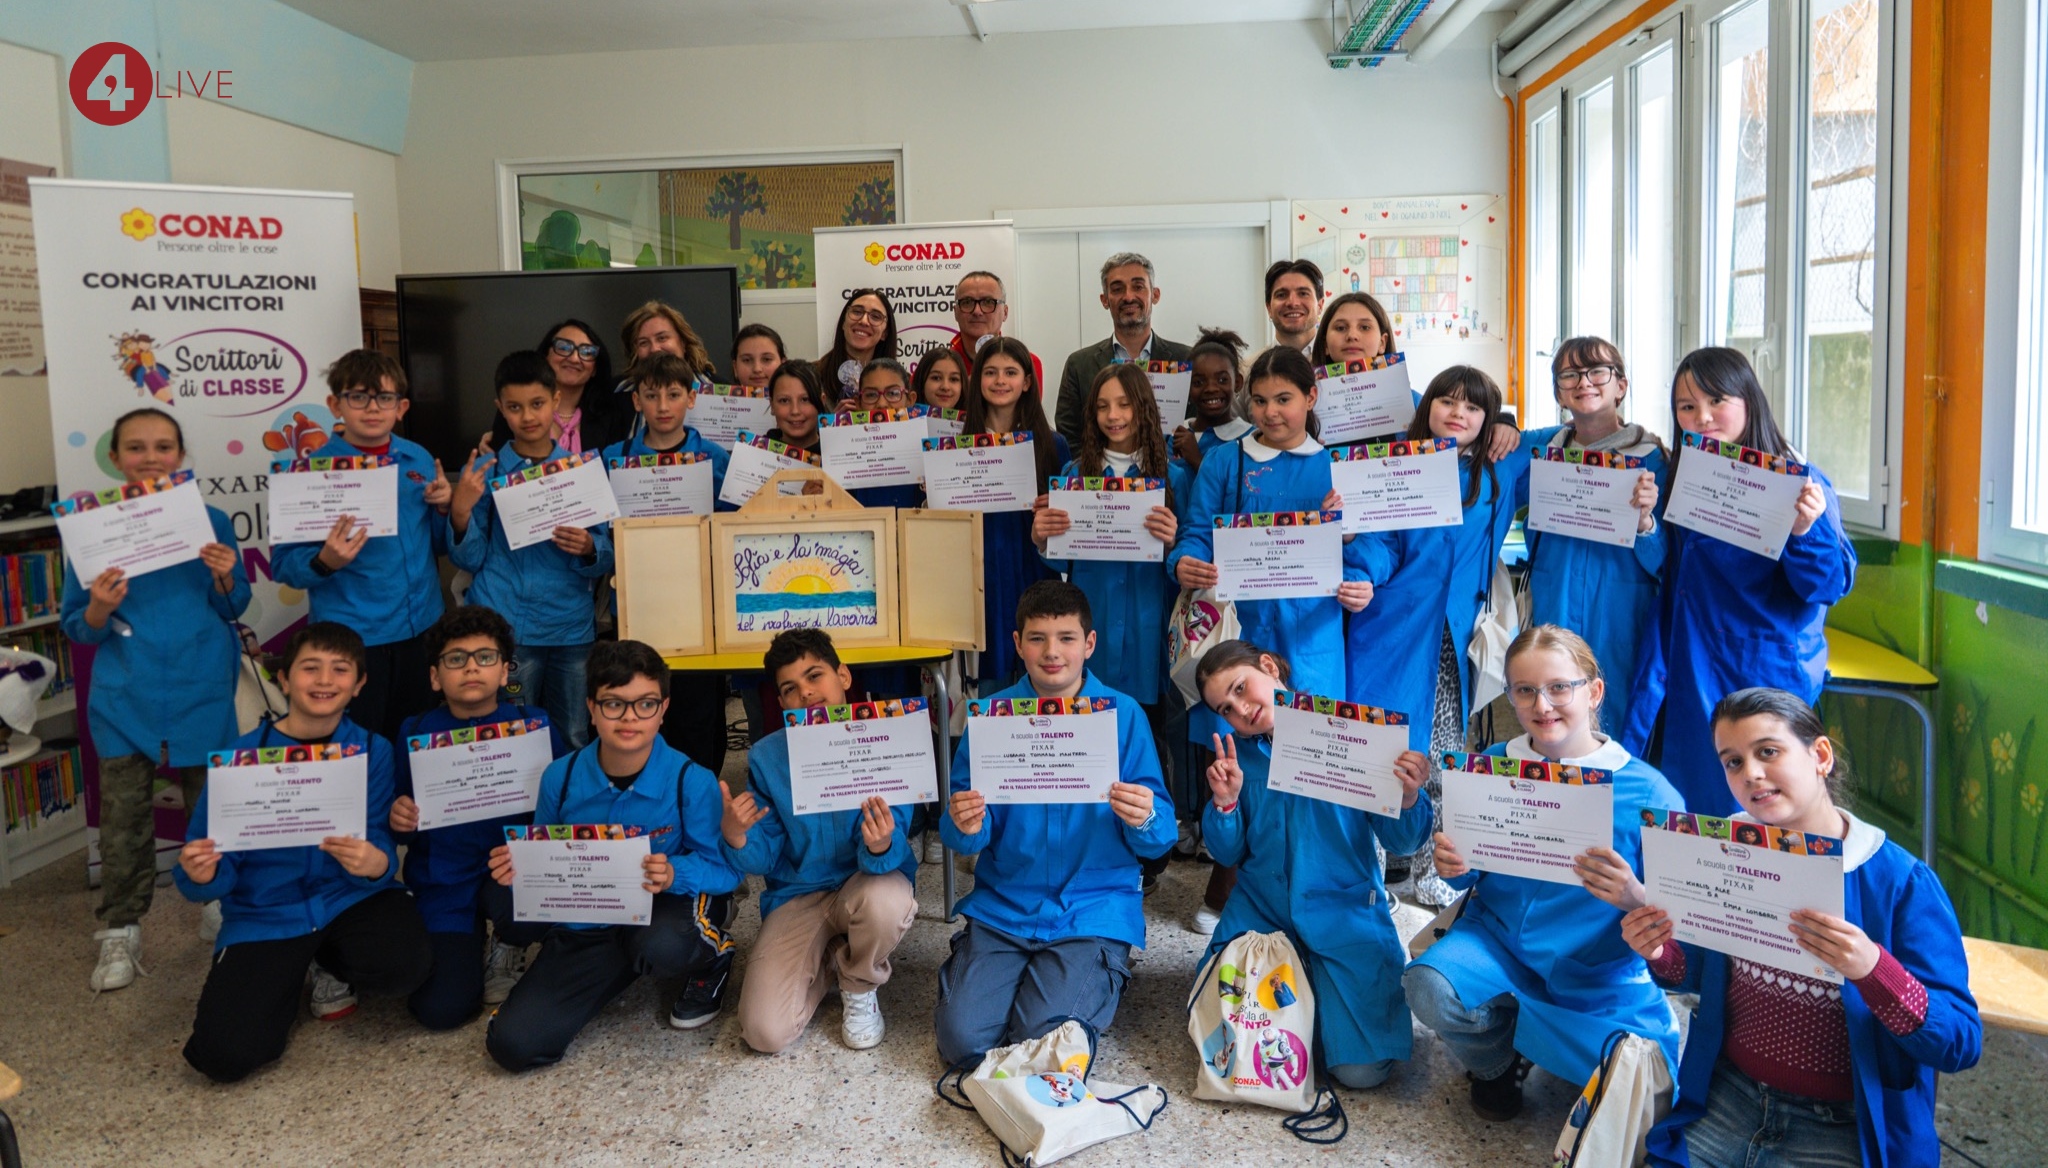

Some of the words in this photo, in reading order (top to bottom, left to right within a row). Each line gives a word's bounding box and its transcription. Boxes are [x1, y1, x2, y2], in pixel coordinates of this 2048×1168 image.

[1397, 199, 1440, 209] ANNALENA?
[1364, 213, 1377, 221] NEL
[1400, 212, 1427, 220] OGNUNO
[159, 214, 282, 240] CONAD
[157, 240, 204, 253] Persone
[209, 241, 235, 253] oltre
[239, 241, 249, 254] le
[252, 244, 278, 255] cose
[887, 242, 965, 262] CONAD
[885, 263, 914, 272] Persone
[916, 263, 934, 271] oltre
[936, 262, 943, 270] le
[83, 273, 316, 290] CONGRATULAZIONI
[131, 296, 156, 311] AI
[163, 296, 283, 311] VINCITORI
[175, 345, 283, 373] Scrittori
[179, 379, 198, 397] di
[203, 378, 285, 396] CLASSE
[1351, 383, 1376, 392] TALENTO
[1392, 469, 1421, 477] TALENTO
[197, 475, 269, 495] XAR
[550, 481, 575, 491] TALENTO
[1584, 480, 1610, 488] TALENTO
[1737, 478, 1766, 491] TALENTO
[734, 547, 770, 589] Sofia
[772, 549, 784, 561] e
[786, 533, 813, 560] la
[815, 544, 865, 576] magia
[737, 612, 754, 632] del
[812, 612, 822, 628] di
[826, 605, 878, 627] lavand
[857, 734, 889, 744] TALENTO
[1315, 729, 1330, 737] scuola
[1337, 734, 1367, 745] TALENTO
[1328, 744, 1348, 752] PIXAR
[480, 752, 512, 762] TALENTO
[1327, 751, 1347, 759] BEATRICE
[1341, 765, 1366, 774] LOMBARDI
[1304, 771, 1325, 779] CONCORSO
[1326, 776, 1349, 785] LETTERARIO
[1350, 781, 1372, 790] NAZIONALE
[1309, 779, 1328, 787] TALENTO
[1329, 783, 1343, 791] SPORT
[1348, 788, 1376, 798] MOVIMENTO
[1494, 795, 1513, 803] scuola
[1522, 798, 1560, 809] TALENTO
[1511, 811, 1537, 819] PIXAR
[1534, 835, 1565, 843] LOMBARDI
[1483, 843, 1510, 851] CONCORSO
[1511, 847, 1540, 856] LETTERARIO
[1542, 851, 1570, 860] NAZIONALE
[1490, 852, 1514, 860] TALENTO
[1516, 855, 1534, 863] SPORT
[1703, 859, 1725, 870] scuola
[1727, 863, 1734, 872] di
[1736, 865, 1780, 882] TALENTO
[1686, 880, 1709, 890] KHALID
[1723, 879, 1753, 891] PIXAR
[1723, 902, 1741, 911] EMMA
[1746, 908, 1777, 920] LOMBARDI
[1735, 916, 1752, 924] VINTO
[1692, 913, 1724, 925] CONCORSO
[1725, 921, 1759, 934] LETTERARIO
[1760, 930, 1793, 943] NAZIONALE
[1681, 918, 1693, 926] PER
[1702, 924, 1729, 936] TALENTO
[1731, 931, 1752, 942] SPORT
[1759, 939, 1800, 955] MOVIMENTO
[1259, 1012, 1267, 1021] di
[1233, 1077, 1262, 1086] CONAD
